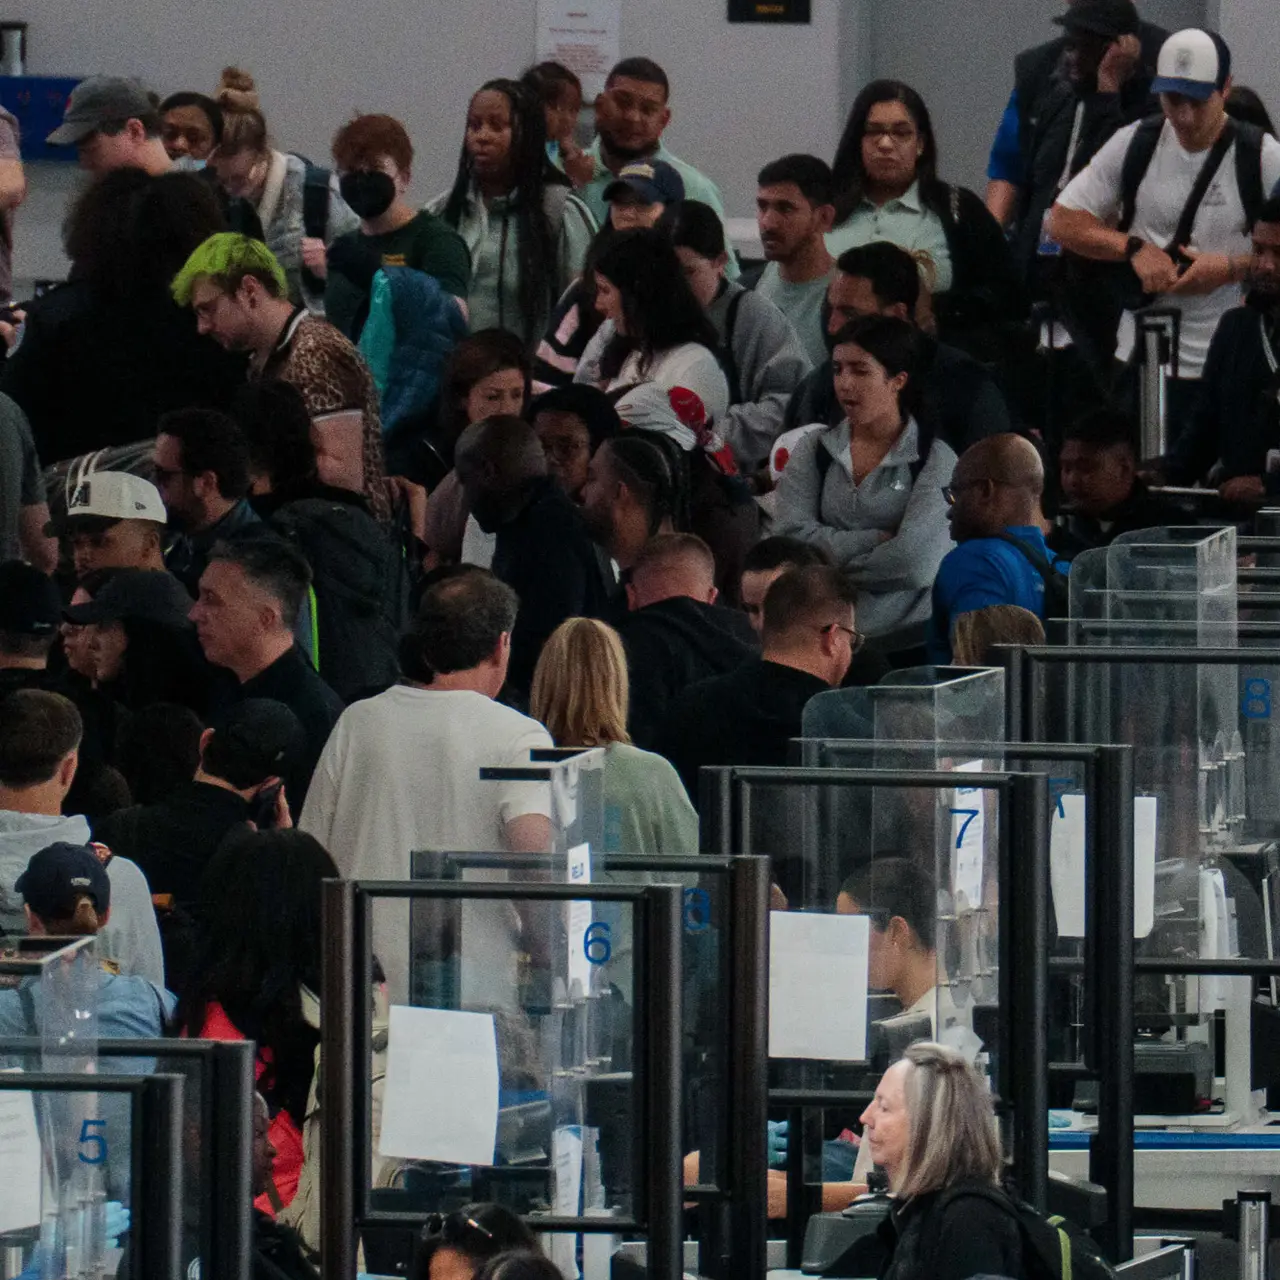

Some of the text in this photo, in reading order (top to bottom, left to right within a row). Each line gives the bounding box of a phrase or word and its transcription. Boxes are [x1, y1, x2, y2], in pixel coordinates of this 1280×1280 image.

[1241, 677, 1272, 718] 8
[950, 808, 979, 849] 7
[583, 922, 611, 965] 6
[78, 1120, 107, 1164] 5
